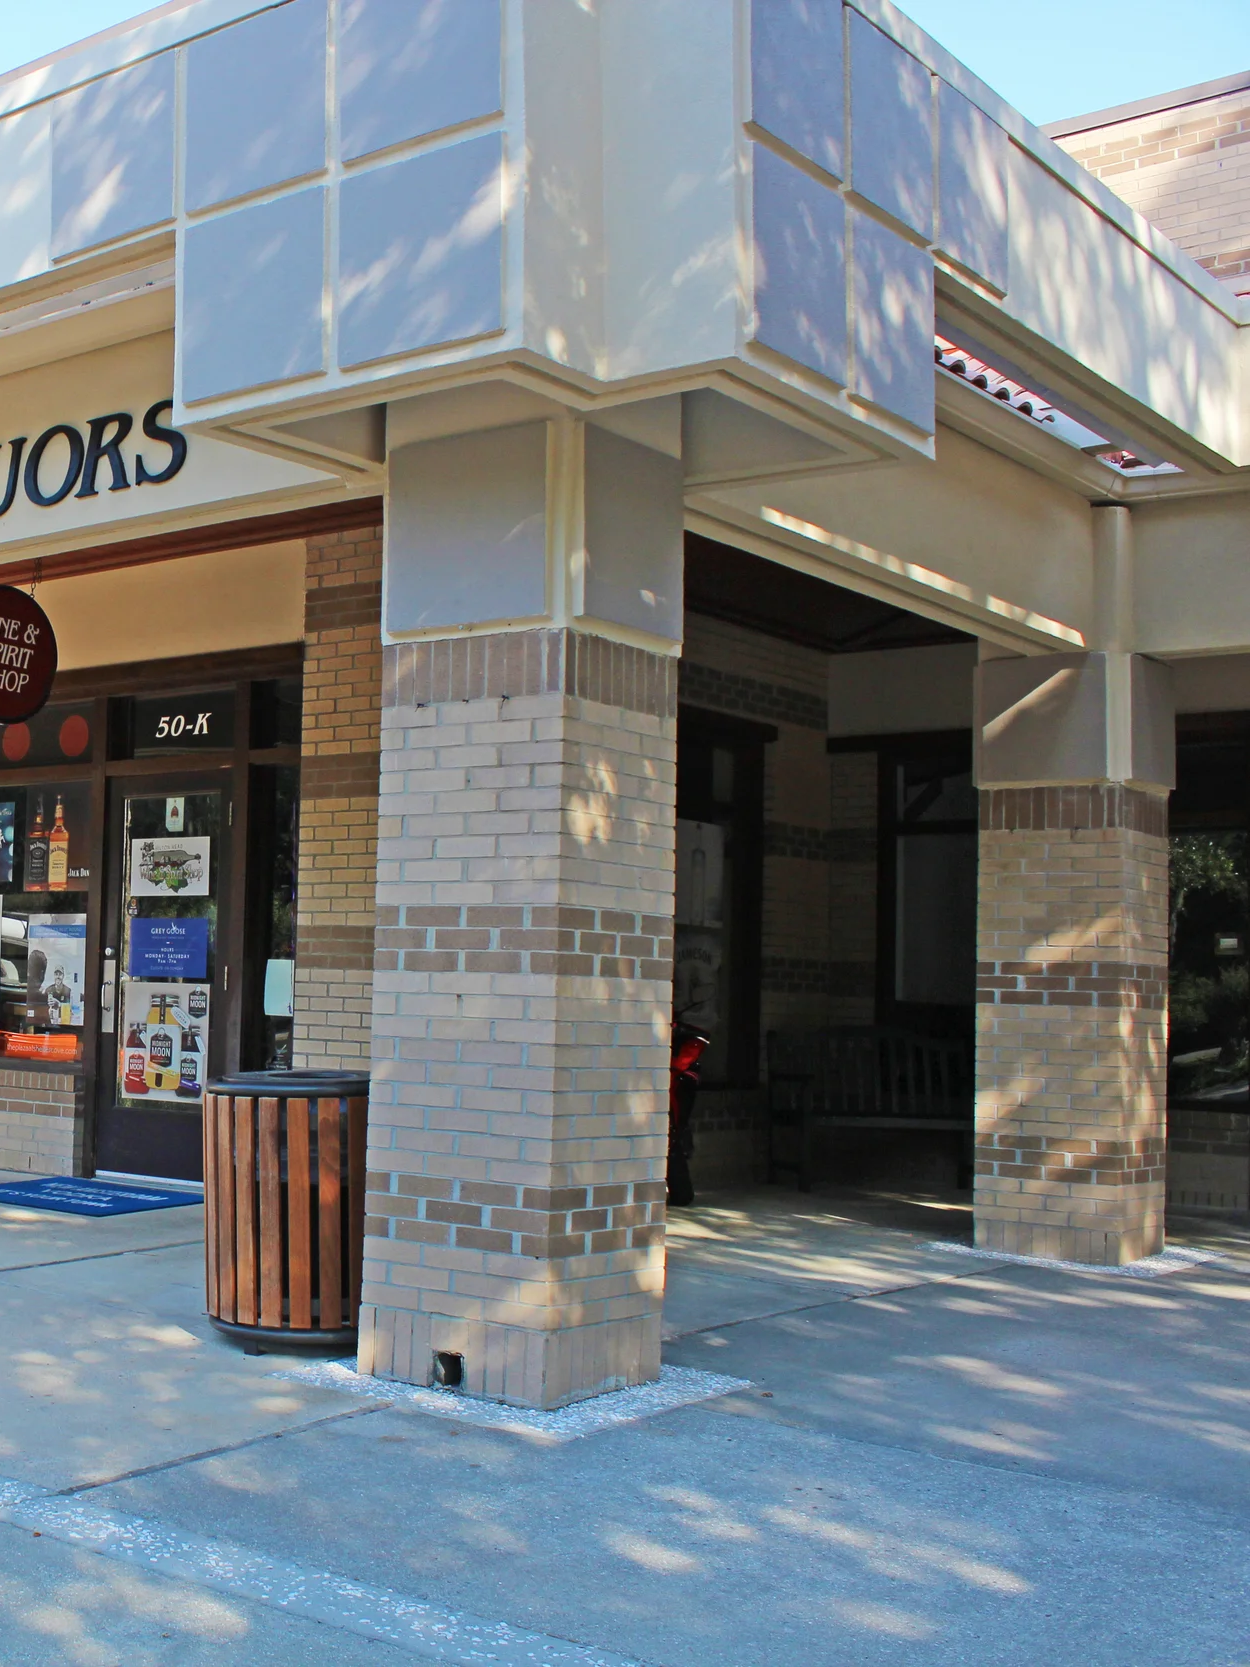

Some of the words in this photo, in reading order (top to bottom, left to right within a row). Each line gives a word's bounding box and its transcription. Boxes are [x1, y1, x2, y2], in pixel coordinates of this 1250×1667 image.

[23, 623, 40, 645] &
[155, 712, 213, 738] 50-K
[67, 868, 80, 877] JACK
[190, 1000, 206, 1008] MOON
[151, 1046, 171, 1056] MOON
[181, 1067, 196, 1075] MOON
